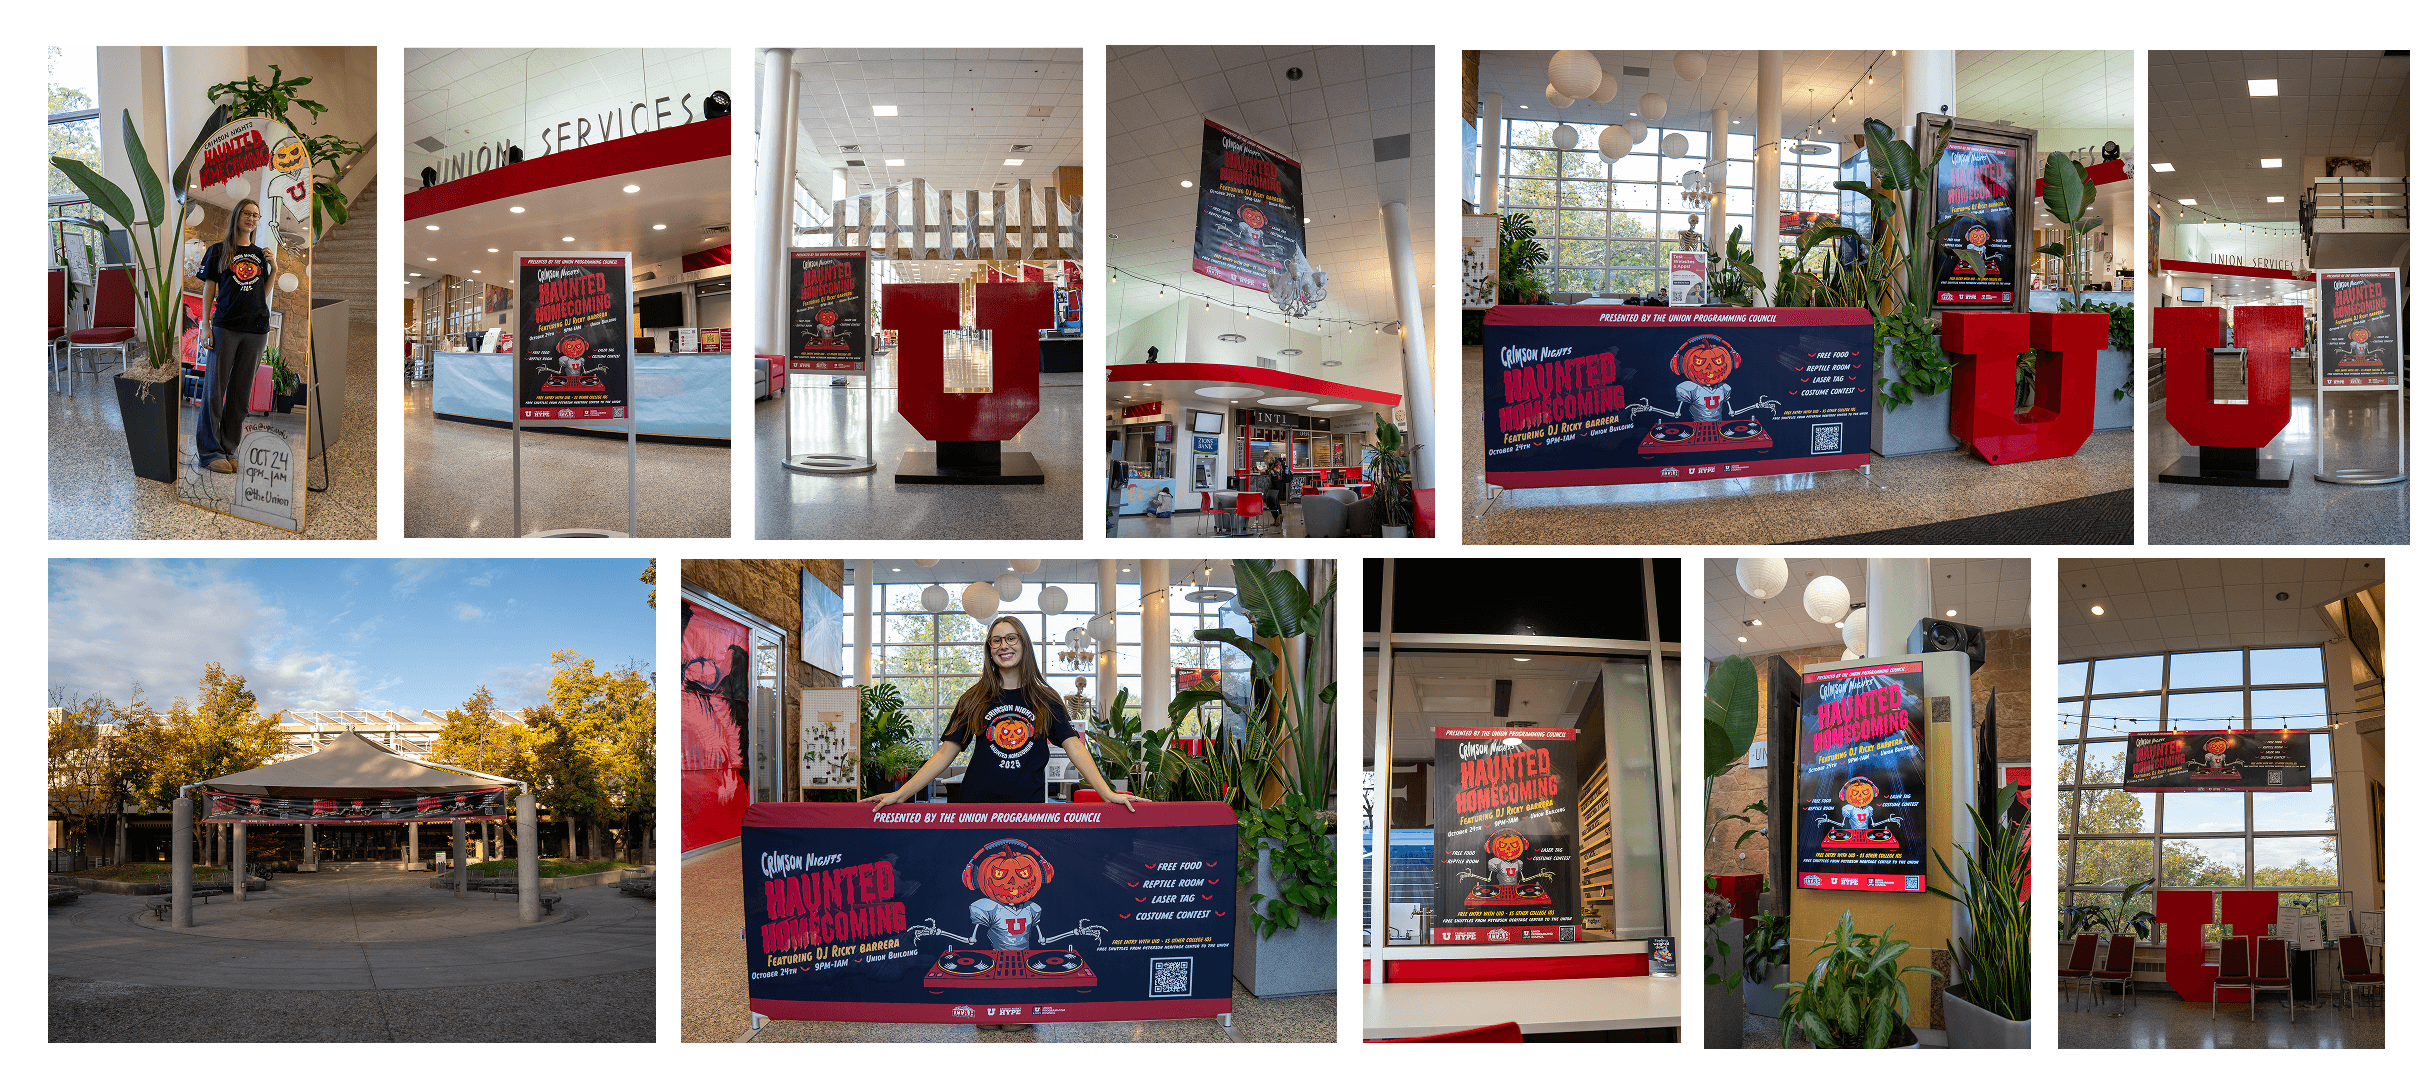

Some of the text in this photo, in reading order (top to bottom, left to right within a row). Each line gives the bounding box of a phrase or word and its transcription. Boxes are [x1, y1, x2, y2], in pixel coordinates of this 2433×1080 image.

[204, 122, 253, 150] CRIMSON NIGHTS
[204, 130, 263, 167] HAUNTED
[436, 93, 693, 185] UNION SERVICES
[199, 145, 269, 191] HOMECOMING
[1224, 150, 1277, 178] HAUNTED
[1951, 163, 2003, 188] HAUNTED
[286, 181, 307, 201] U
[1220, 167, 1281, 193] HOMECOMING
[1948, 182, 2007, 205] HOMECOMING
[803, 262, 851, 287] HAUNTED
[2210, 253, 2294, 271] UNION SERVICES
[537, 268, 559, 283] CRIMSON
[539, 272, 606, 305] HAUNTED
[801, 278, 855, 300] HOMECOMING
[2334, 282, 2382, 307] HAUNTED
[535, 293, 611, 324] HOMECOMING
[1599, 313, 1778, 322] PRESENTED BY THE UNION PROGRAMMING COUNCIL
[2333, 297, 2386, 319] HOMECOMING
[564, 318, 571, 326] DJ
[882, 283, 1054, 441] U
[1501, 345, 1573, 369] CRIMSON NIGHTS
[1806, 363, 1850, 372] REPTILE ROOM
[1504, 352, 1616, 404] HAUNTED
[1832, 375, 1844, 383] TAG
[1942, 311, 2109, 464] U
[2153, 306, 2303, 447] U
[1704, 396, 1720, 410] U
[1801, 387, 1855, 396] COSTUME CONTEST
[1258, 412, 1286, 424] INTI
[1499, 385, 1625, 433] HOMECOMING
[1488, 446, 1514, 456] OCTOBER
[1546, 434, 1576, 445] 9PM-1AM
[1590, 428, 1608, 437] UNION
[1609, 423, 1635, 433] BUILDING
[1503, 415, 1619, 445] FEATURING DJ RICKY BARRERA
[250, 448, 288, 471] OCT 24
[1819, 678, 1873, 700] CRIMSON NIGHTS
[984, 704, 1013, 721] CRIMSON
[1818, 684, 1901, 729] HAUNTED
[1813, 709, 1908, 753] HOMECOMING
[1458, 741, 1488, 761] CRIMSON
[1818, 738, 1903, 764] FEATURING DJ RICKY BARRERA
[2136, 740, 2183, 762] HAUNTED
[998, 759, 1021, 769] 2025
[1460, 748, 1551, 790] HAUNTED
[2132, 754, 2186, 774] HOMECOMING
[1455, 775, 1558, 814] HOMECOMING
[873, 812, 1101, 823] PRESENTED BY THE UNION PROGRAMMING COUNCIL
[1447, 828, 1468, 838] OCTOBER
[1494, 817, 1519, 828] 9PM-1AM
[1530, 811, 1544, 820] UNION
[1459, 799, 1554, 826] FEATURING DJ RICKY BARRERA
[761, 850, 842, 879] CRIMSON NIGHTS
[1157, 861, 1203, 871] FREE FOOD
[765, 860, 895, 920] HAUNTED
[1142, 878, 1205, 888] REPTILE ROOM
[1151, 893, 1196, 904] LASER TAG
[1006, 918, 1027, 936] U
[1135, 910, 1211, 920] COSTUME CONTEST
[761, 901, 906, 955] HOMECOMING
[751, 949, 918, 980] OCTOBER 24TH 9PM-1AM UNION BUILDING
[767, 938, 900, 967] FEATURING DJ RICKY BARRERA
